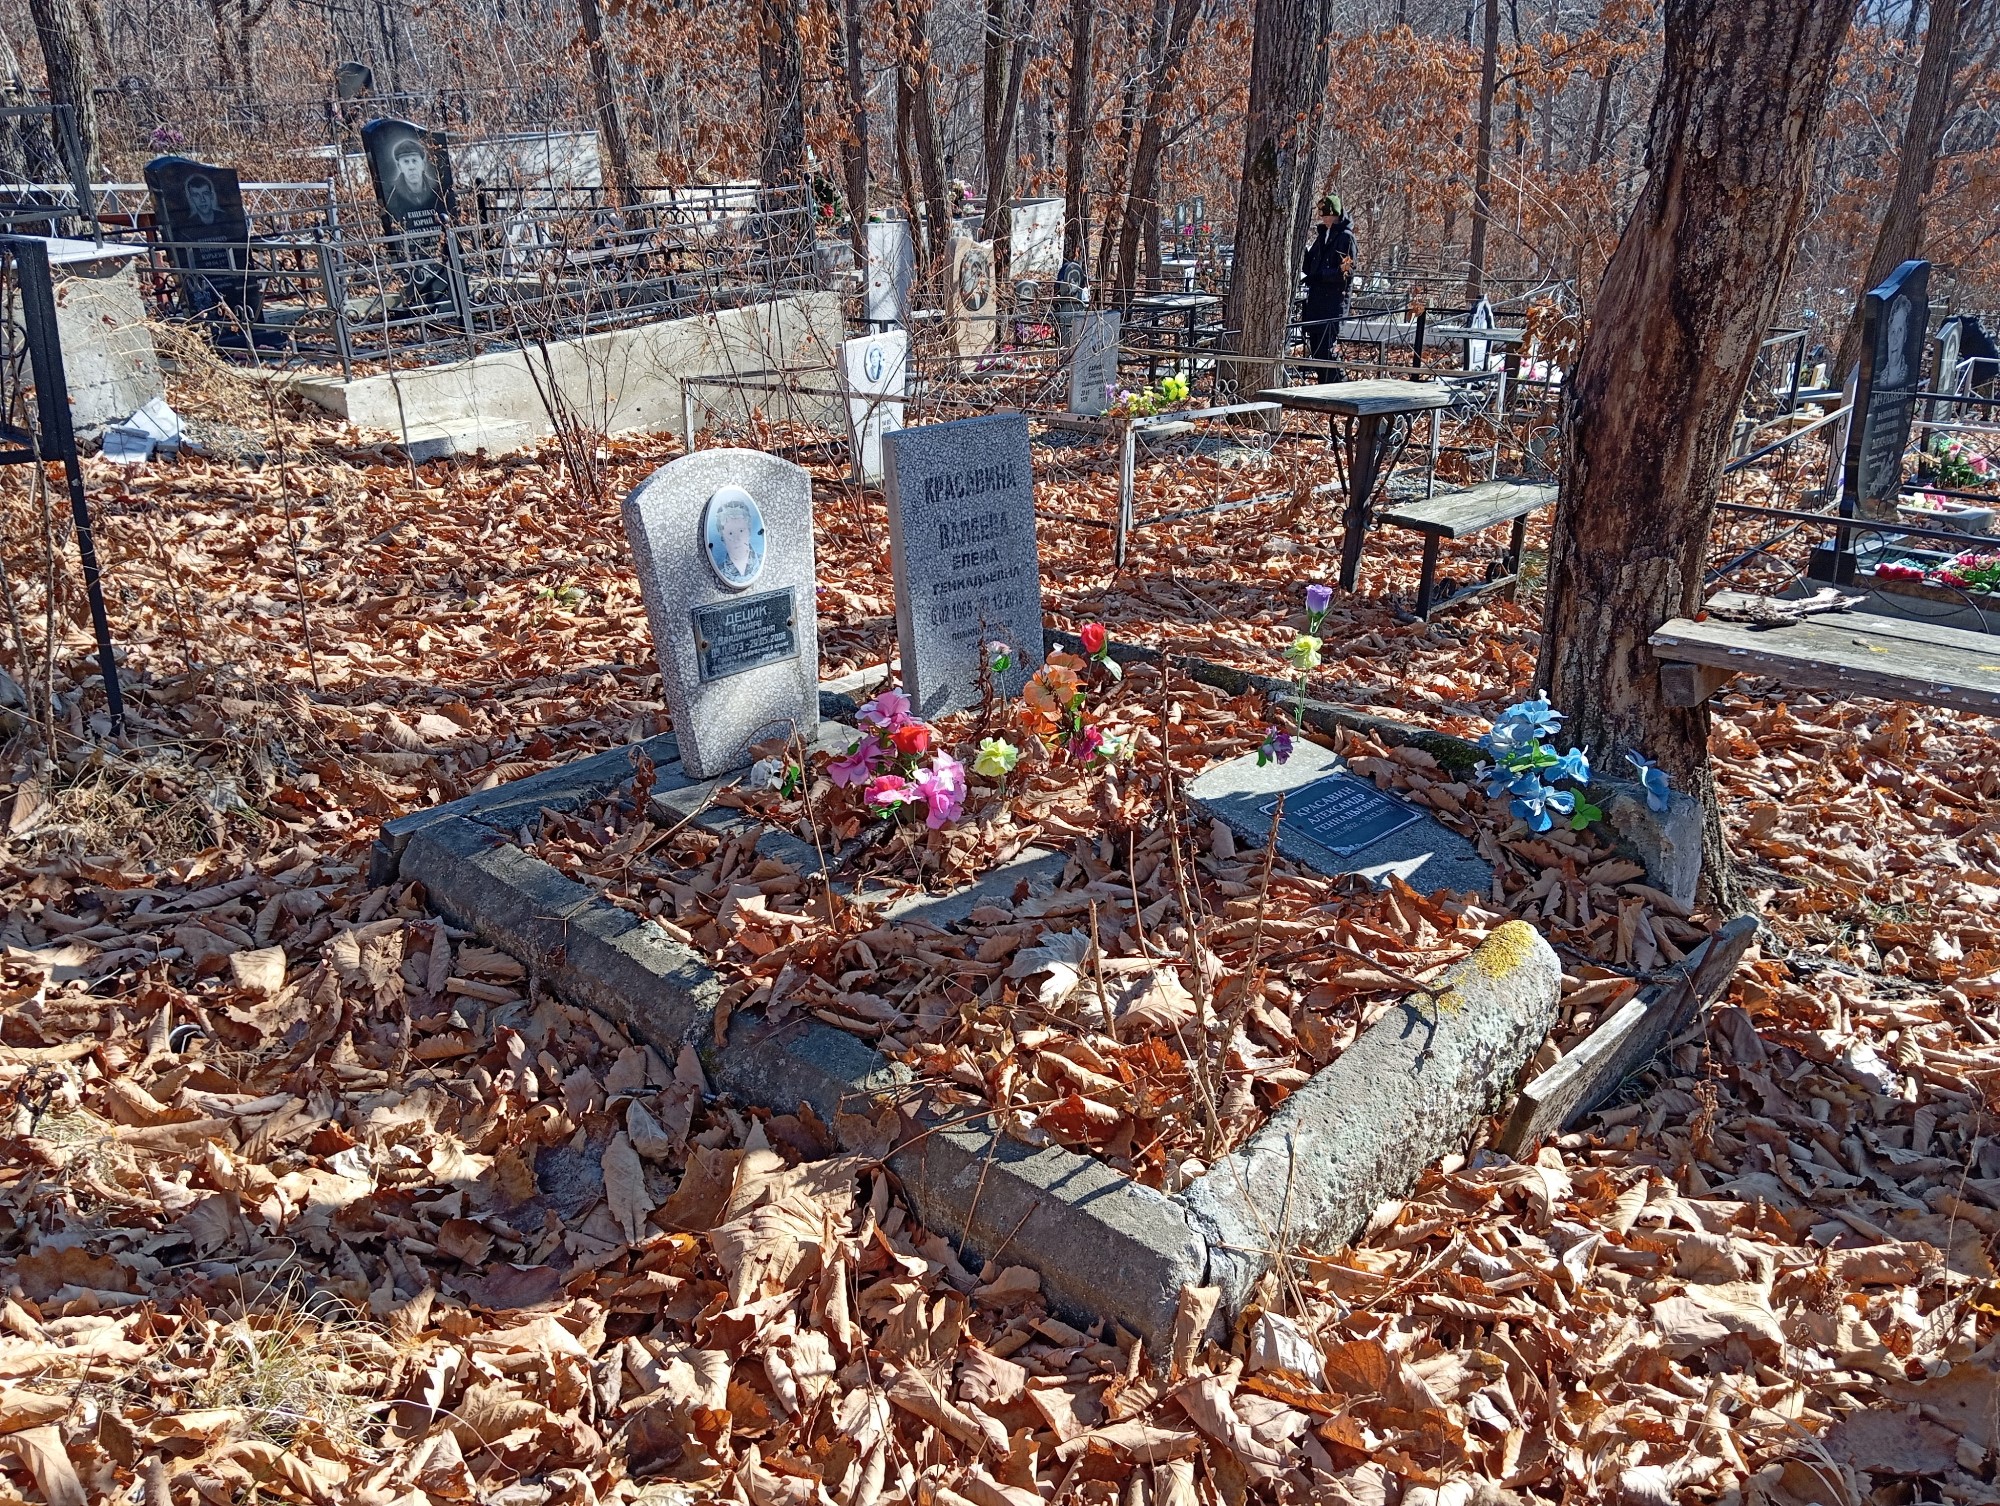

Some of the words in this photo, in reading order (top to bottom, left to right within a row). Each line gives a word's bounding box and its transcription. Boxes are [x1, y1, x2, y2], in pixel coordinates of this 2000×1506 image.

[925, 463, 1016, 504] КРАСАВИНА
[953, 548, 999, 570] ЕЛЕНА
[933, 566, 1020, 596] ГЕННАДЬЕВНА
[725, 605, 768, 626] ДЕЦИК
[1293, 786, 1356, 817] КРАСАВИН
[1307, 793, 1367, 825] АЛЕКСАНДР
[1313, 797, 1384, 833] ГЕННАДЬЕВИЧ
